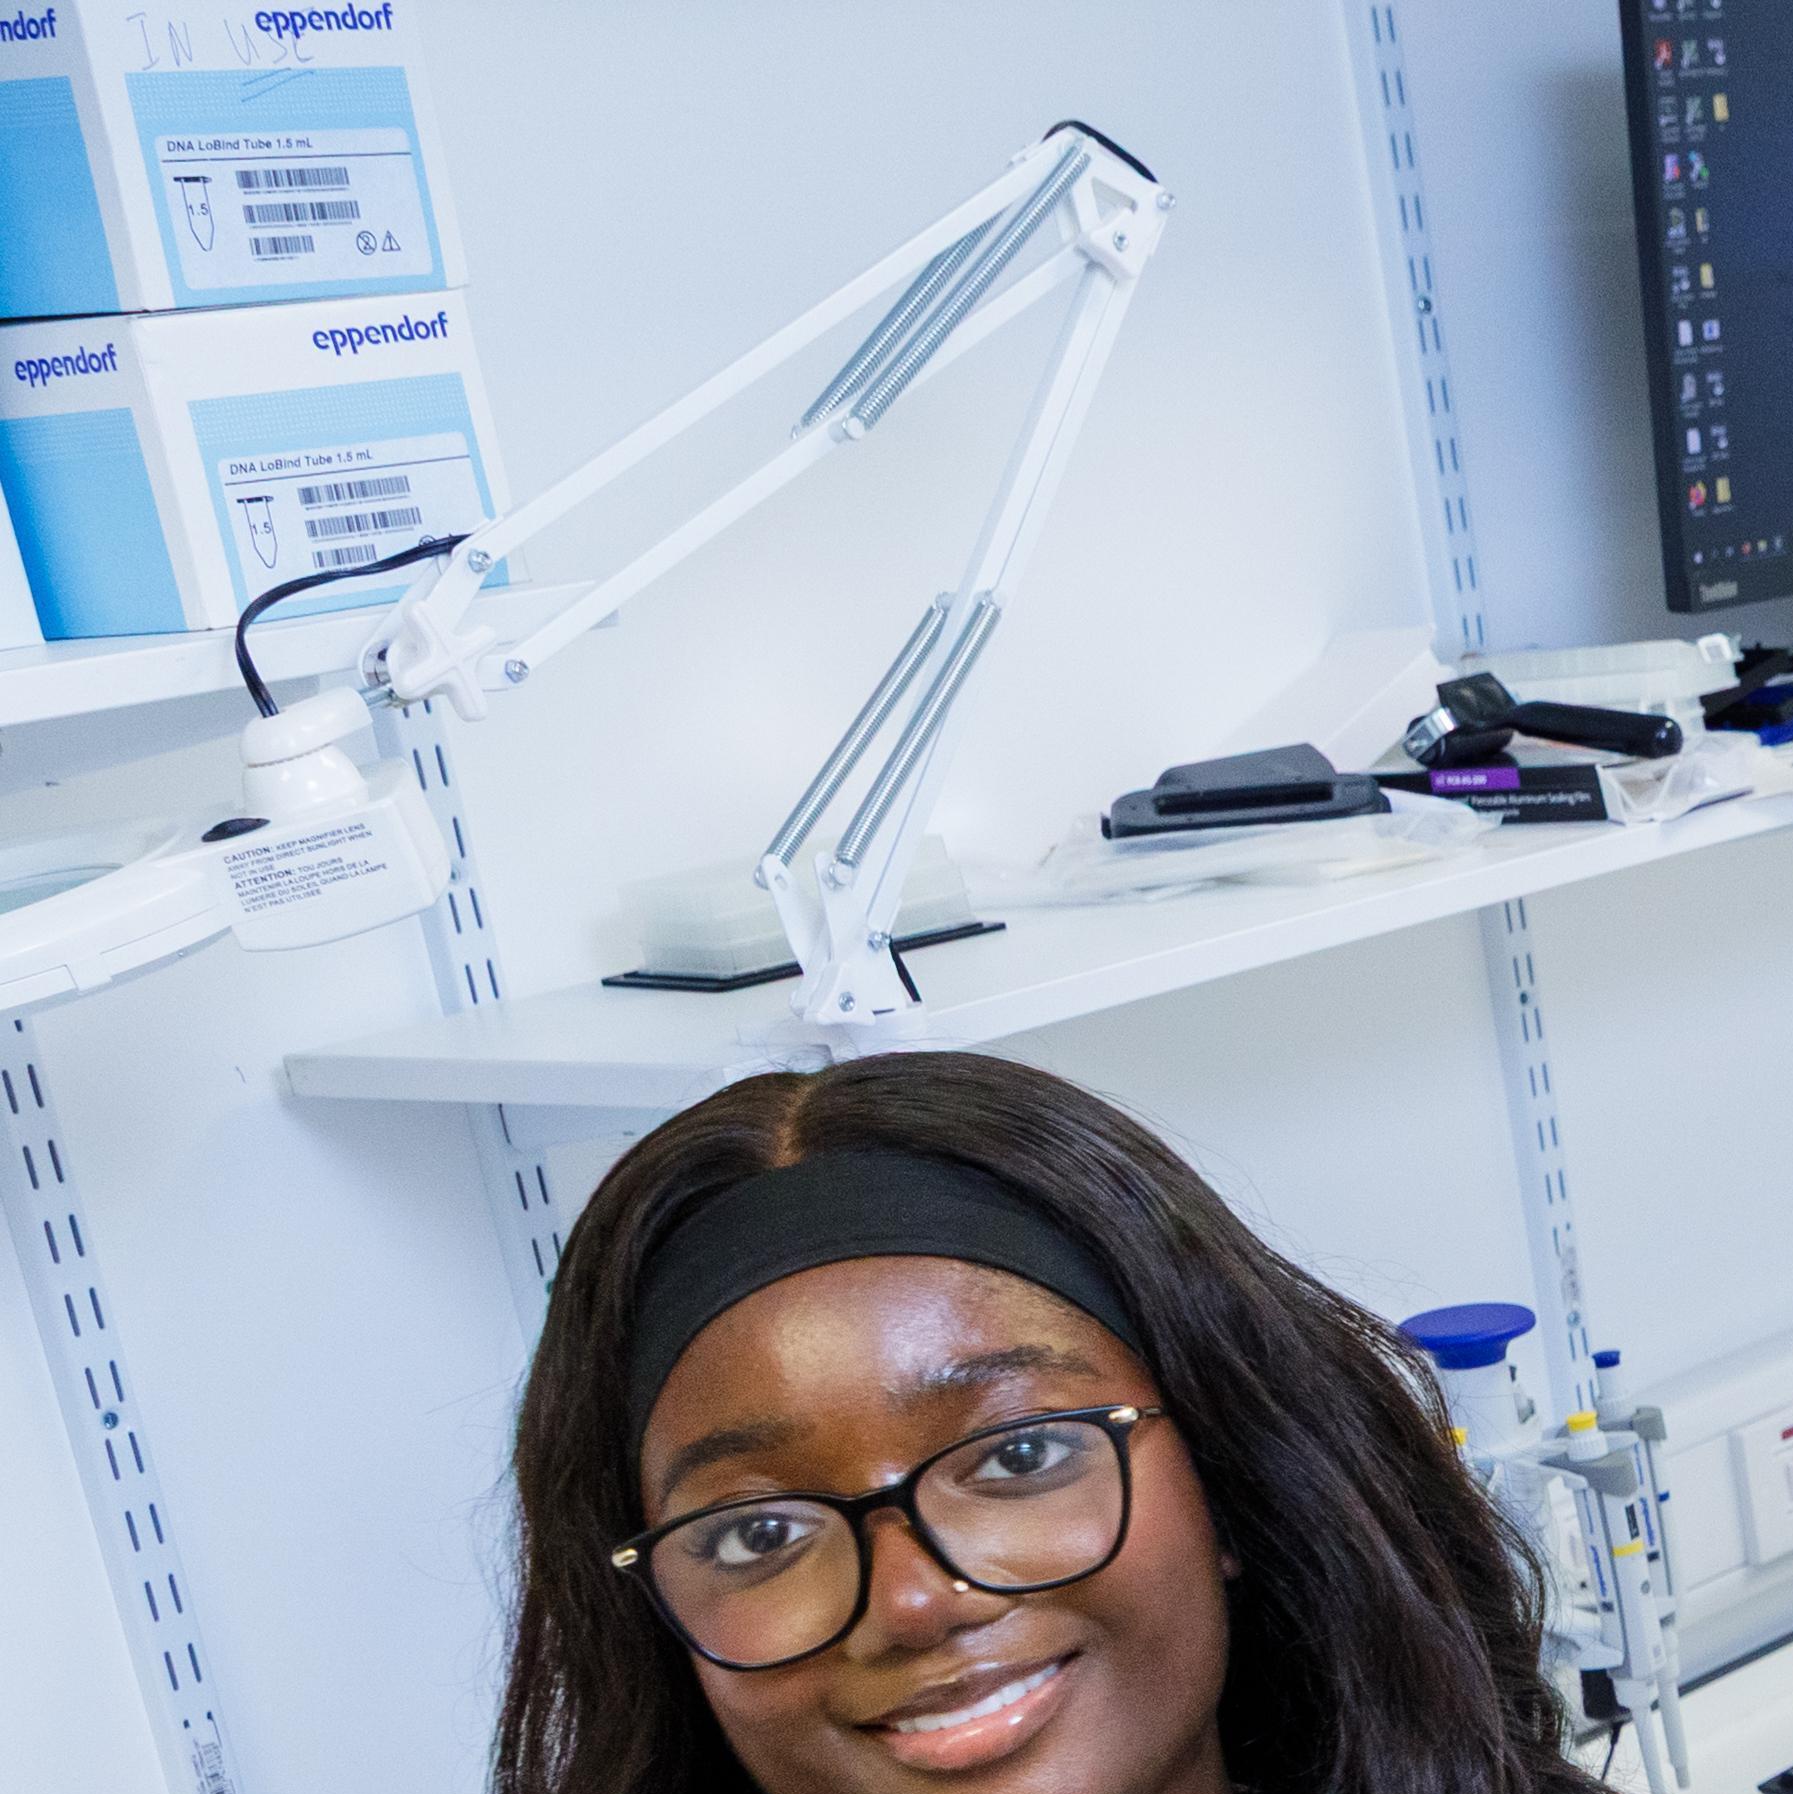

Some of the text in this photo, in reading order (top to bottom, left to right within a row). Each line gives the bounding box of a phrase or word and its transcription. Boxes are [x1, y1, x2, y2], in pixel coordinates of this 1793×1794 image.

[0, 8, 56, 42] ndorf
[255, 2, 394, 39] eppendorf
[126, 7, 316, 70] IN USE
[167, 138, 314, 152] DNA LoBind Tube 1.5 mL
[188, 204, 209, 216] 1.5
[312, 311, 448, 356] eppendorf
[15, 343, 118, 388] eppendorf
[229, 449, 373, 475] DNA LoBind Tube 1.5 mL
[251, 522, 272, 535] 1.5
[224, 824, 365, 864] CAUTION: KEEP MAGNIFIER LENS
[228, 831, 372, 872] AWAY FROM DIRECT SUNLIGHT WHEN
[231, 871, 248, 879] NOT
[259, 864, 274, 872] USE
[234, 868, 295, 889] ATTENTION:
[238, 882, 281, 897] MAINTENIR
[323, 866, 345, 875] HORS
[291, 881, 318, 892] SOLEIL
[320, 873, 348, 885] QUAND
[361, 863, 387, 874] LAMPE
[269, 898, 284, 906] PAS
